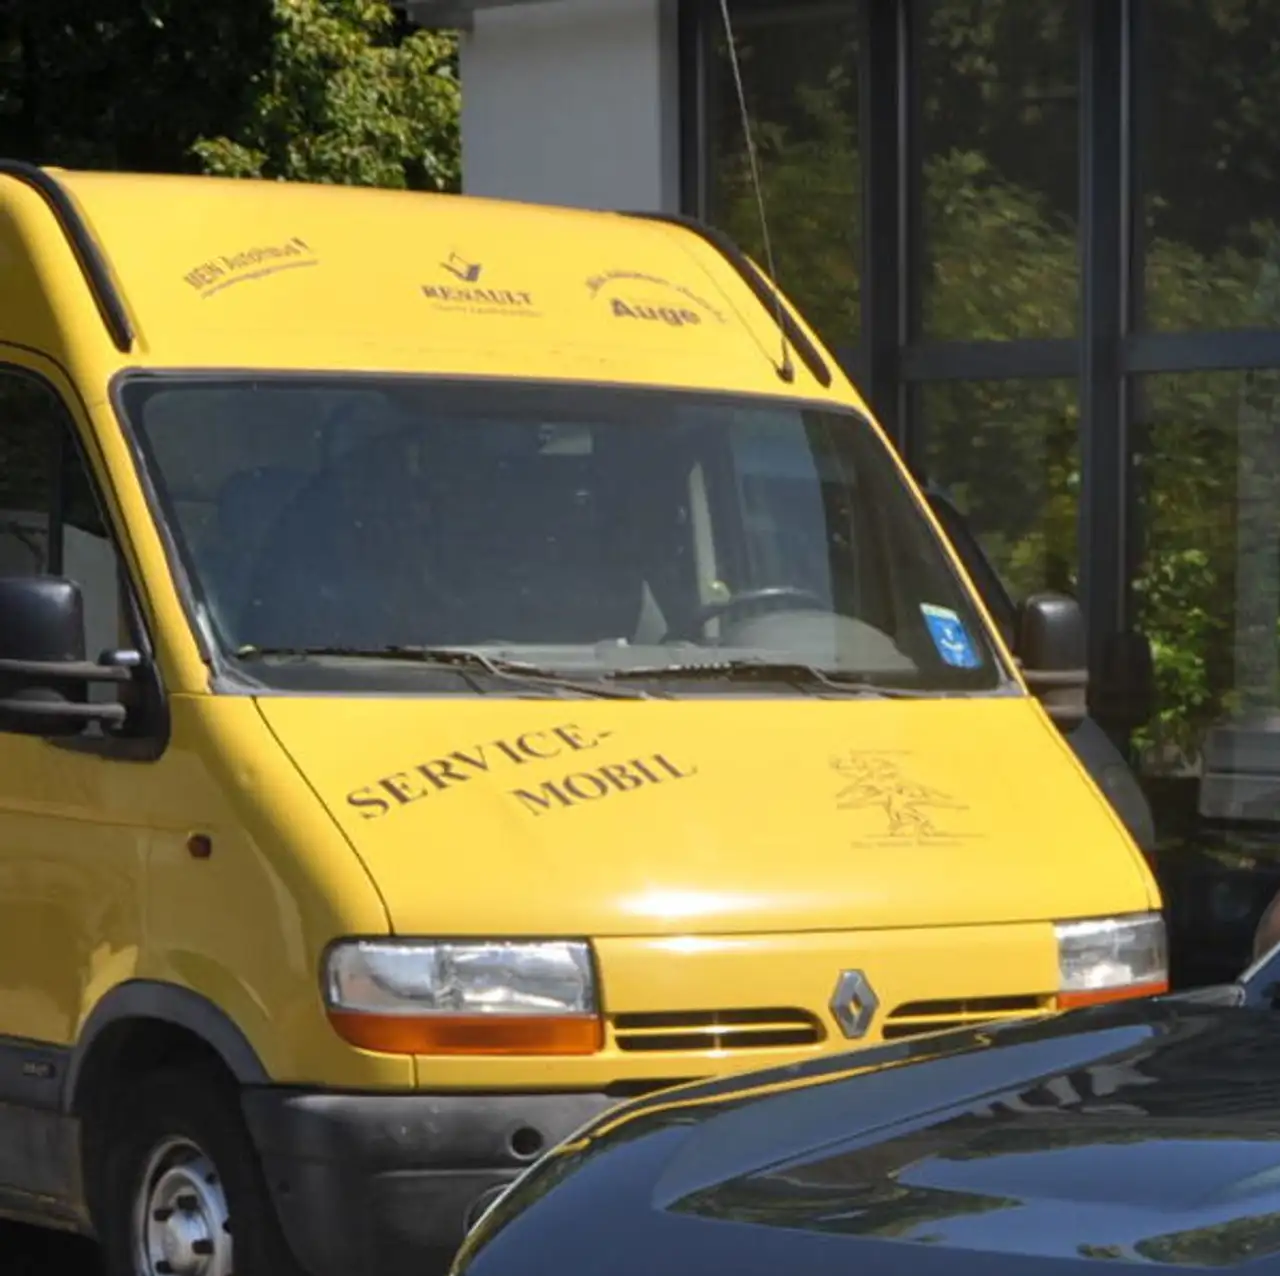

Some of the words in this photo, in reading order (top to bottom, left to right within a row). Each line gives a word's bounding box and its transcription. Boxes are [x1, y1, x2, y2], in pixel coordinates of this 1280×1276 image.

[421, 285, 534, 306] RENAULT
[610, 297, 702, 327] Auge
[345, 722, 613, 820] SERVICE-
[507, 753, 698, 817] MOBIL
